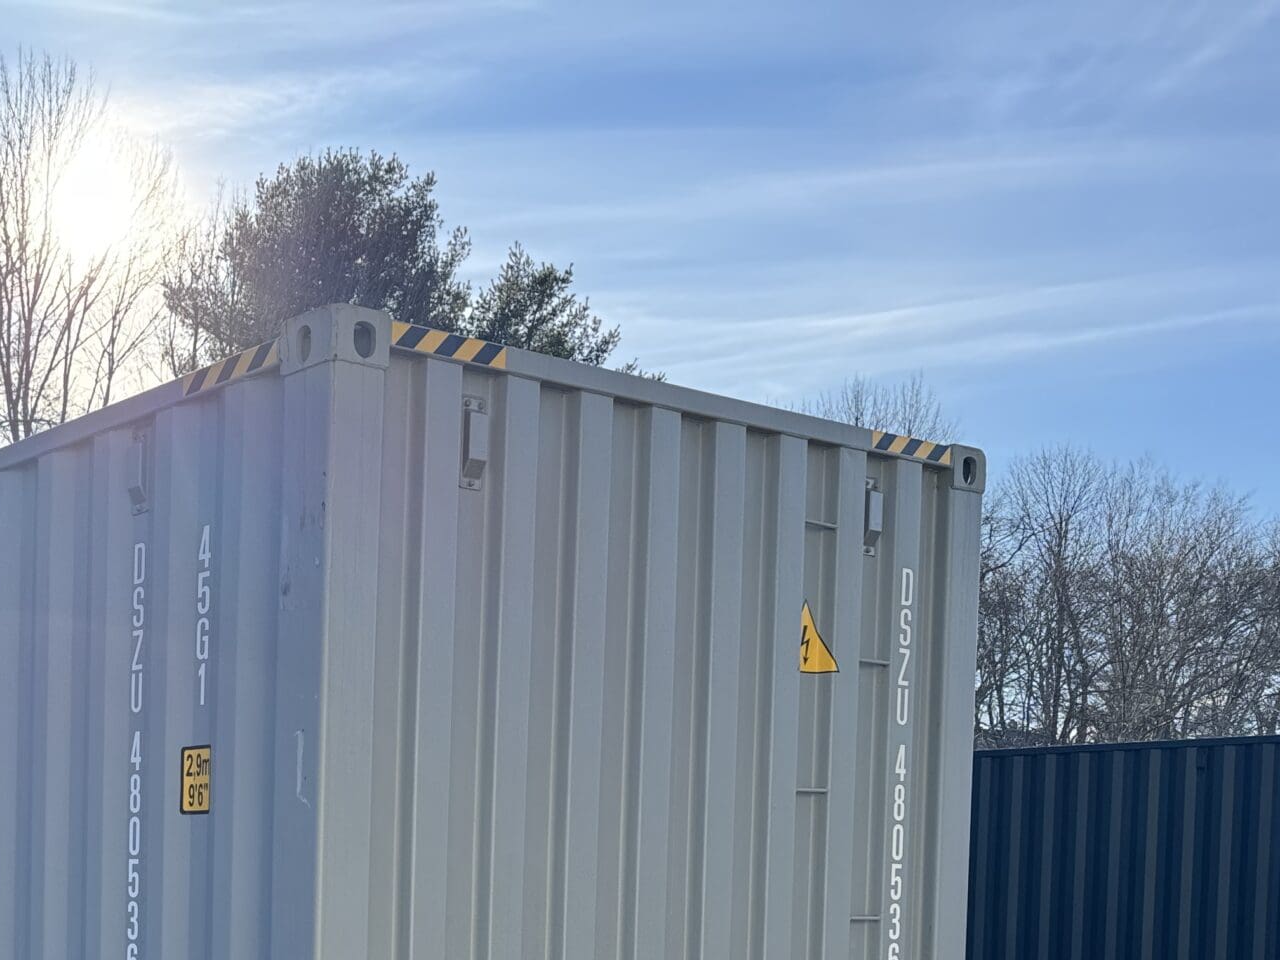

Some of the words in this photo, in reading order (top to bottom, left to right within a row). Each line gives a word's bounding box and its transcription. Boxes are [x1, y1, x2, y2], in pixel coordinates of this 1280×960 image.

[130, 542, 146, 714] DSZU
[195, 524, 212, 706] 45G1
[896, 567, 914, 726] DSZU
[188, 783, 209, 807] 9'6"
